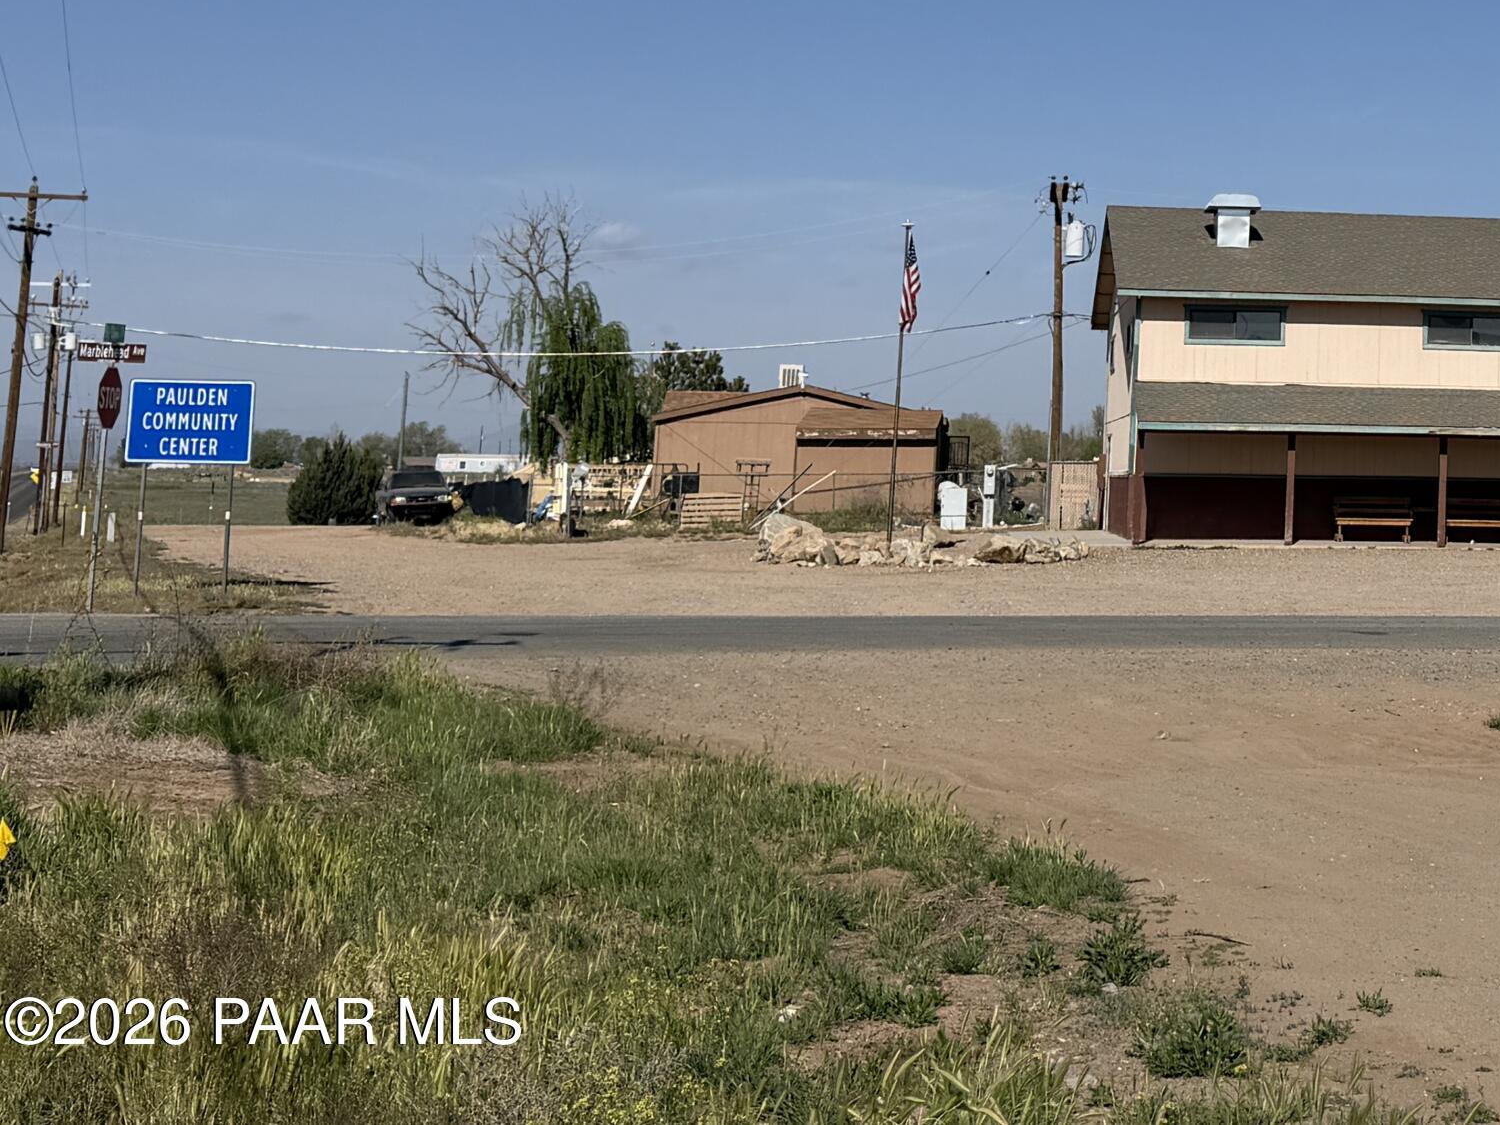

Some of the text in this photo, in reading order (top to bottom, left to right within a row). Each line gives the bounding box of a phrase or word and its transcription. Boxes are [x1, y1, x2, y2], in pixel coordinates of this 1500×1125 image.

[133, 345, 145, 356] Ave
[99, 386, 120, 410] STOP
[156, 387, 228, 406] PAULDEN
[142, 411, 239, 431] COMMUNITY
[159, 437, 218, 456] CENTER
